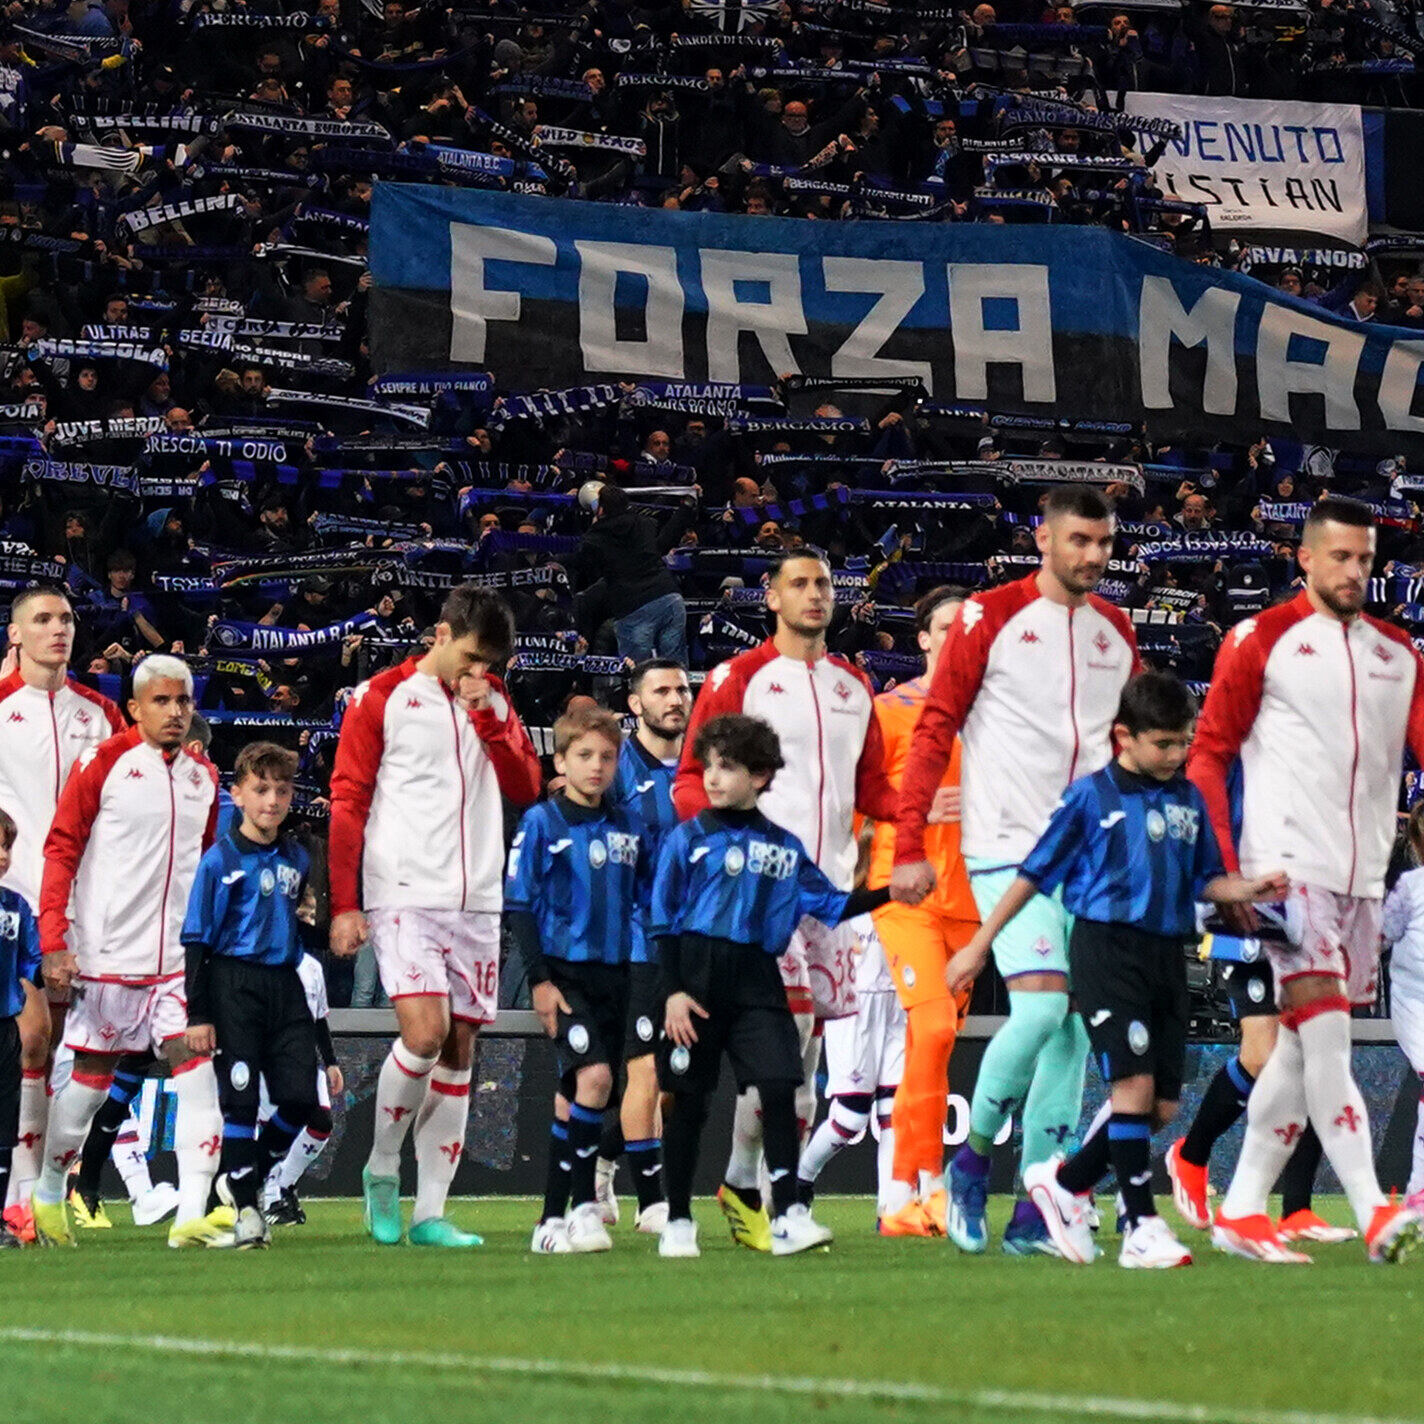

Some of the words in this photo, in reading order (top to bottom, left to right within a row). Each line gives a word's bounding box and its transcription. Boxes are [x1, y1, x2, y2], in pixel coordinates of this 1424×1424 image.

[204, 13, 309, 28] BERGAMO
[618, 74, 710, 92] BERGAMO
[95, 115, 202, 133] BELLINI
[1153, 120, 1345, 164] VENUTO
[438, 152, 483, 169] ATALANTA
[125, 193, 240, 233] BELLINI
[449, 221, 1057, 403] FORZA
[381, 382, 416, 395] SEMPRE
[419, 382, 432, 394] AL
[454, 379, 487, 392] FIANCO
[664, 384, 742, 400] ATALANTA
[56, 420, 102, 440] JUVE
[108, 416, 169, 435] MERDA
[747, 420, 856, 433] BERGAMO
[215, 441, 231, 458] TI
[242, 443, 288, 464] ODIO
[871, 500, 972, 511] ATALANTA
[252, 628, 326, 649] ATALANTA
[474, 959, 496, 996] 16
